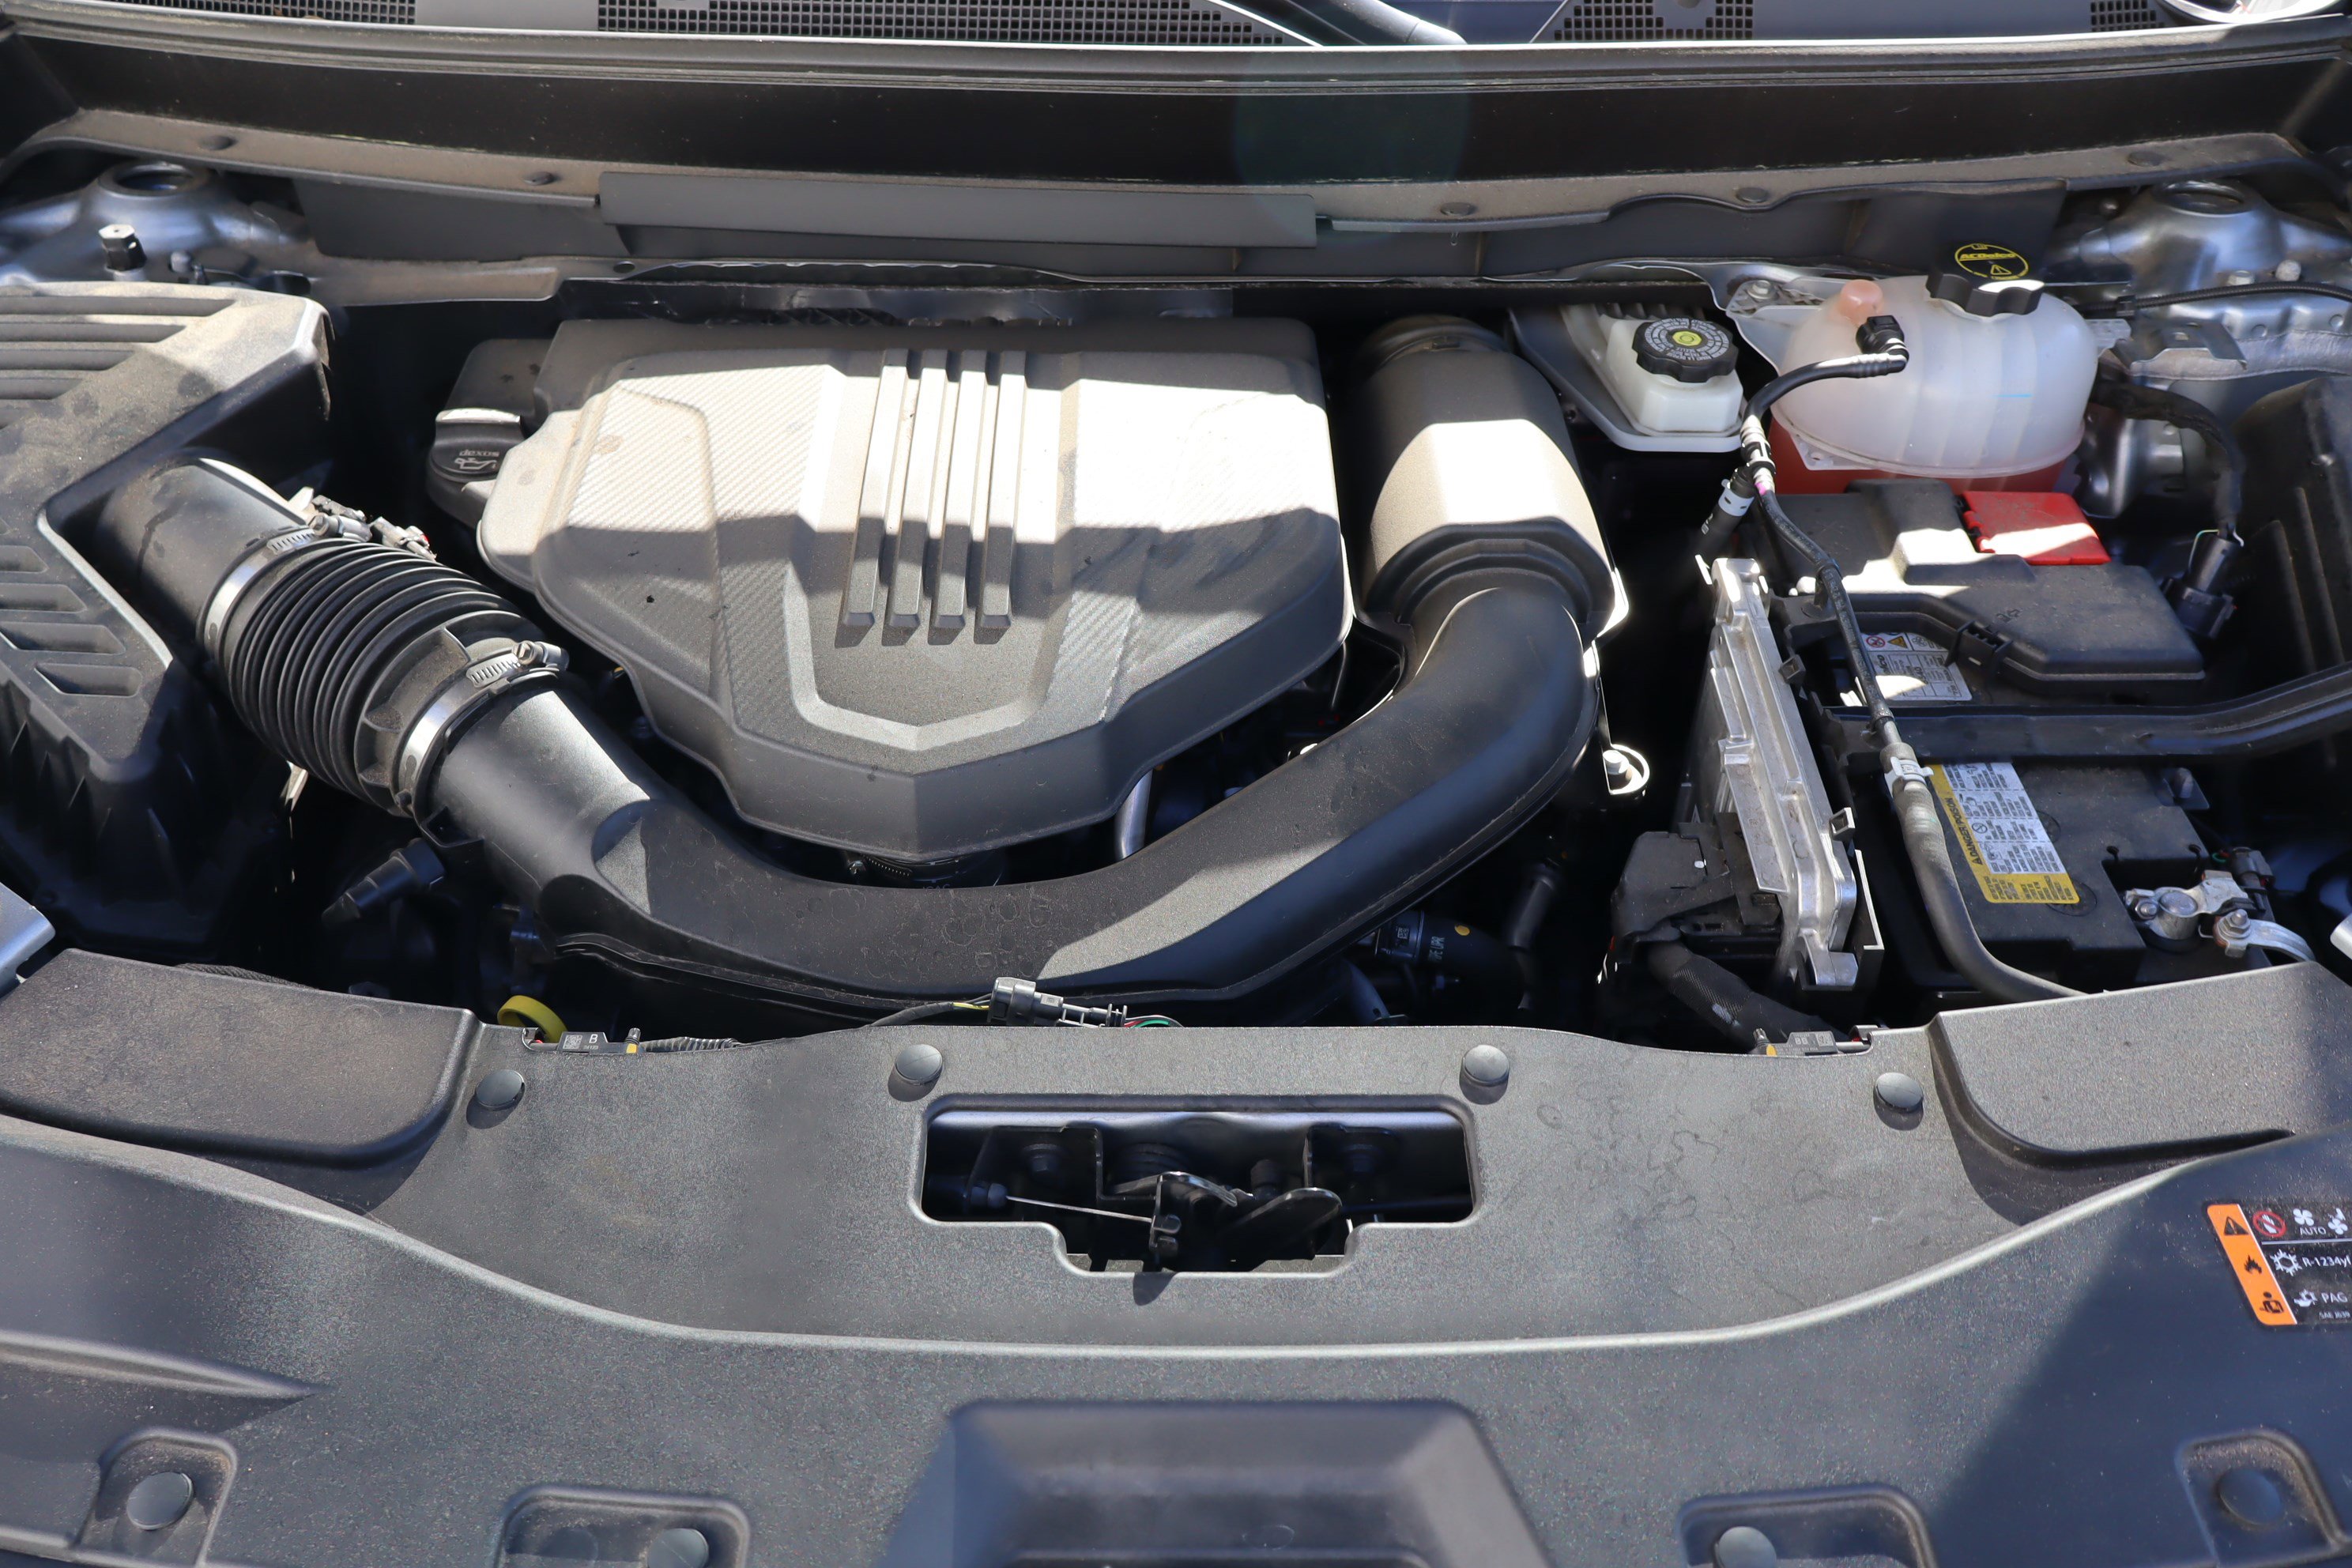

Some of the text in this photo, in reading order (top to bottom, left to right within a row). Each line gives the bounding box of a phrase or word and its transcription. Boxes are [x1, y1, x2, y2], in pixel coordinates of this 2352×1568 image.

[589, 1034, 598, 1044] B
[2300, 1227, 2327, 1236] AUTO
[2321, 1291, 2348, 1304] PAG
